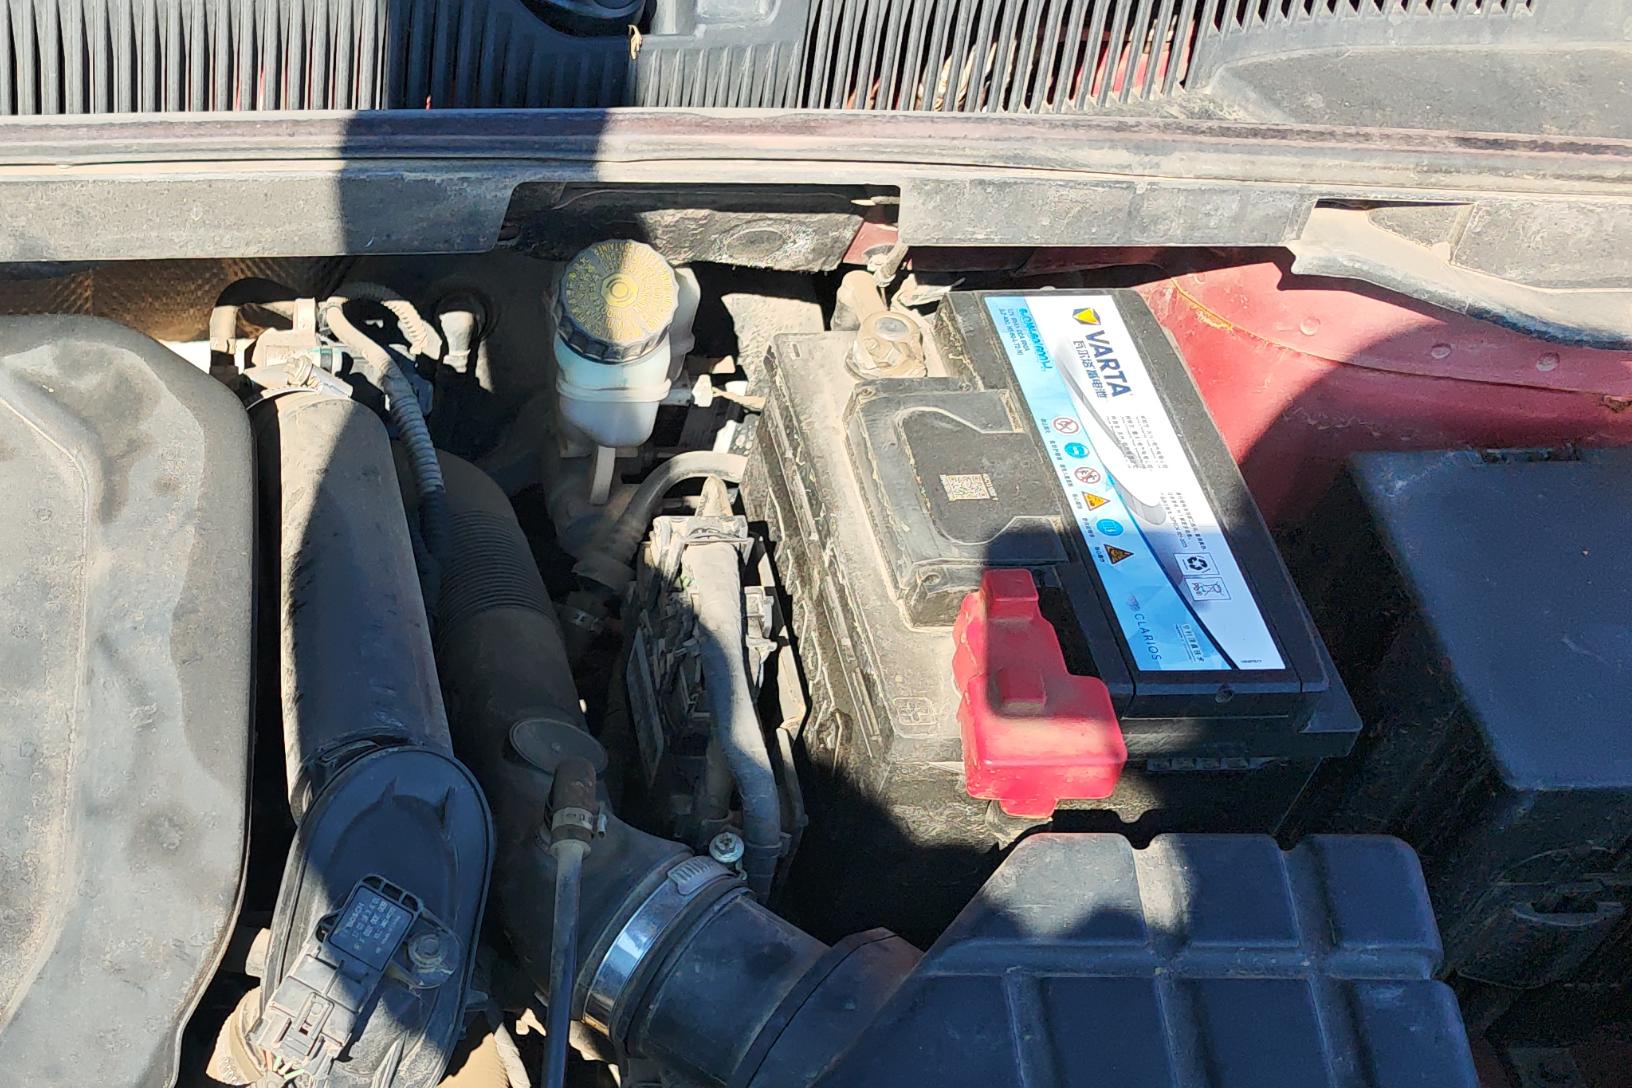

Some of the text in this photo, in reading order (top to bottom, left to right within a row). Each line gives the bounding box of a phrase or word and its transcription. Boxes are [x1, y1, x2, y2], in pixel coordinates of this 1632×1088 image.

[1085, 330, 1132, 397] VARTA
[1134, 613, 1162, 660] CLARIOS
[346, 902, 365, 928] BOSCH
